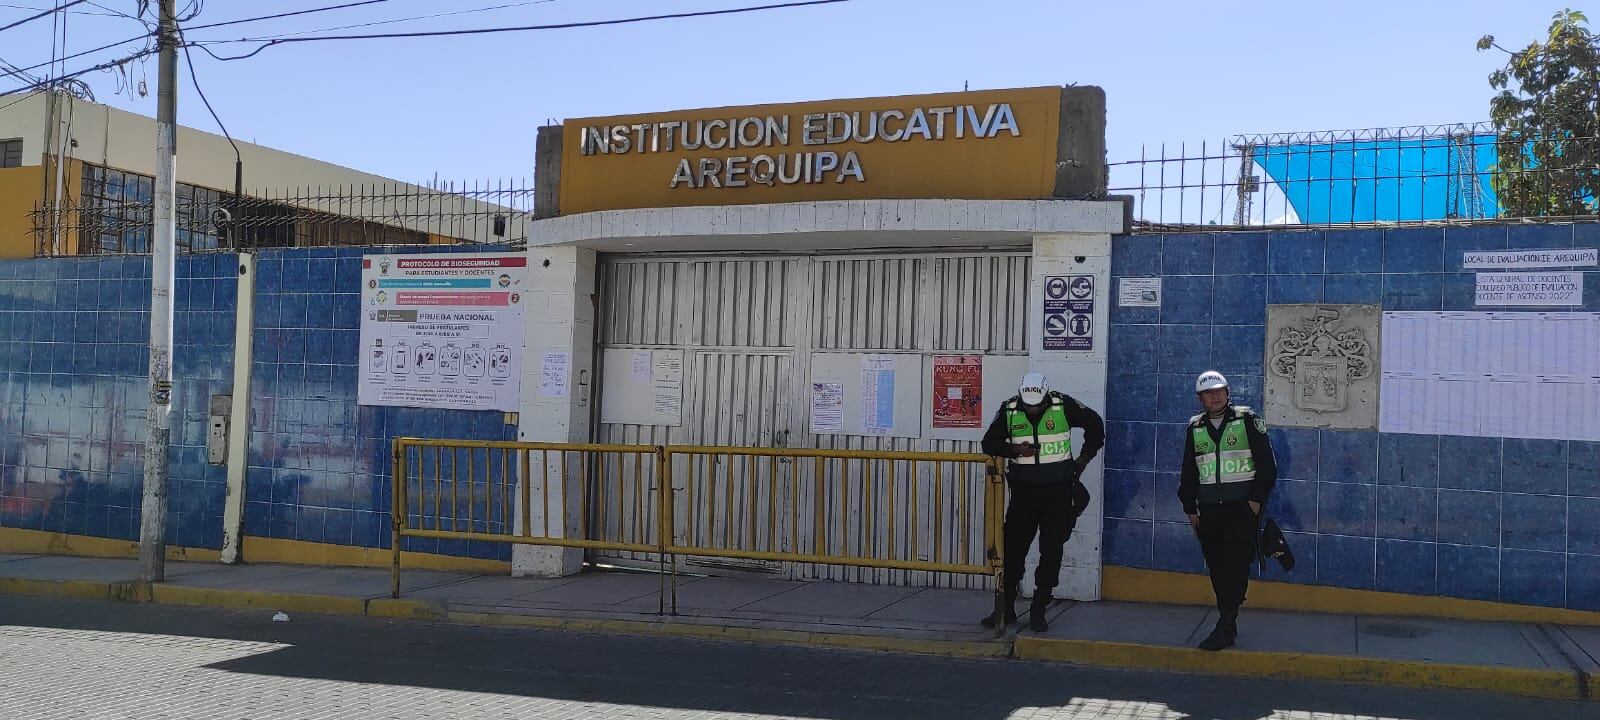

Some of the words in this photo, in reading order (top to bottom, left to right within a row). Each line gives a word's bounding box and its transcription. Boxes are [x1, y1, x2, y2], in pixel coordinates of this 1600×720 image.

[580, 114, 789, 156] INSTITUCION
[802, 103, 1021, 146] EDUCATIVA
[669, 150, 866, 189] AREQUIPA
[1464, 255, 1484, 263] LOCAL
[1487, 255, 1496, 263] DE
[1553, 252, 1595, 263] AREQUIPA
[401, 260, 440, 268] PROTOCOLO
[451, 259, 500, 267] BIOSEGURIDAD
[1496, 275, 1524, 283] GENERAL
[1527, 275, 1536, 283] DE
[1537, 274, 1572, 283] DOCENTES
[1506, 292, 1514, 300] DE
[1518, 292, 1546, 300] ASCENSO
[453, 313, 495, 321] NACIONAL
[936, 365, 963, 373] KUNG
[967, 365, 980, 373] FU
